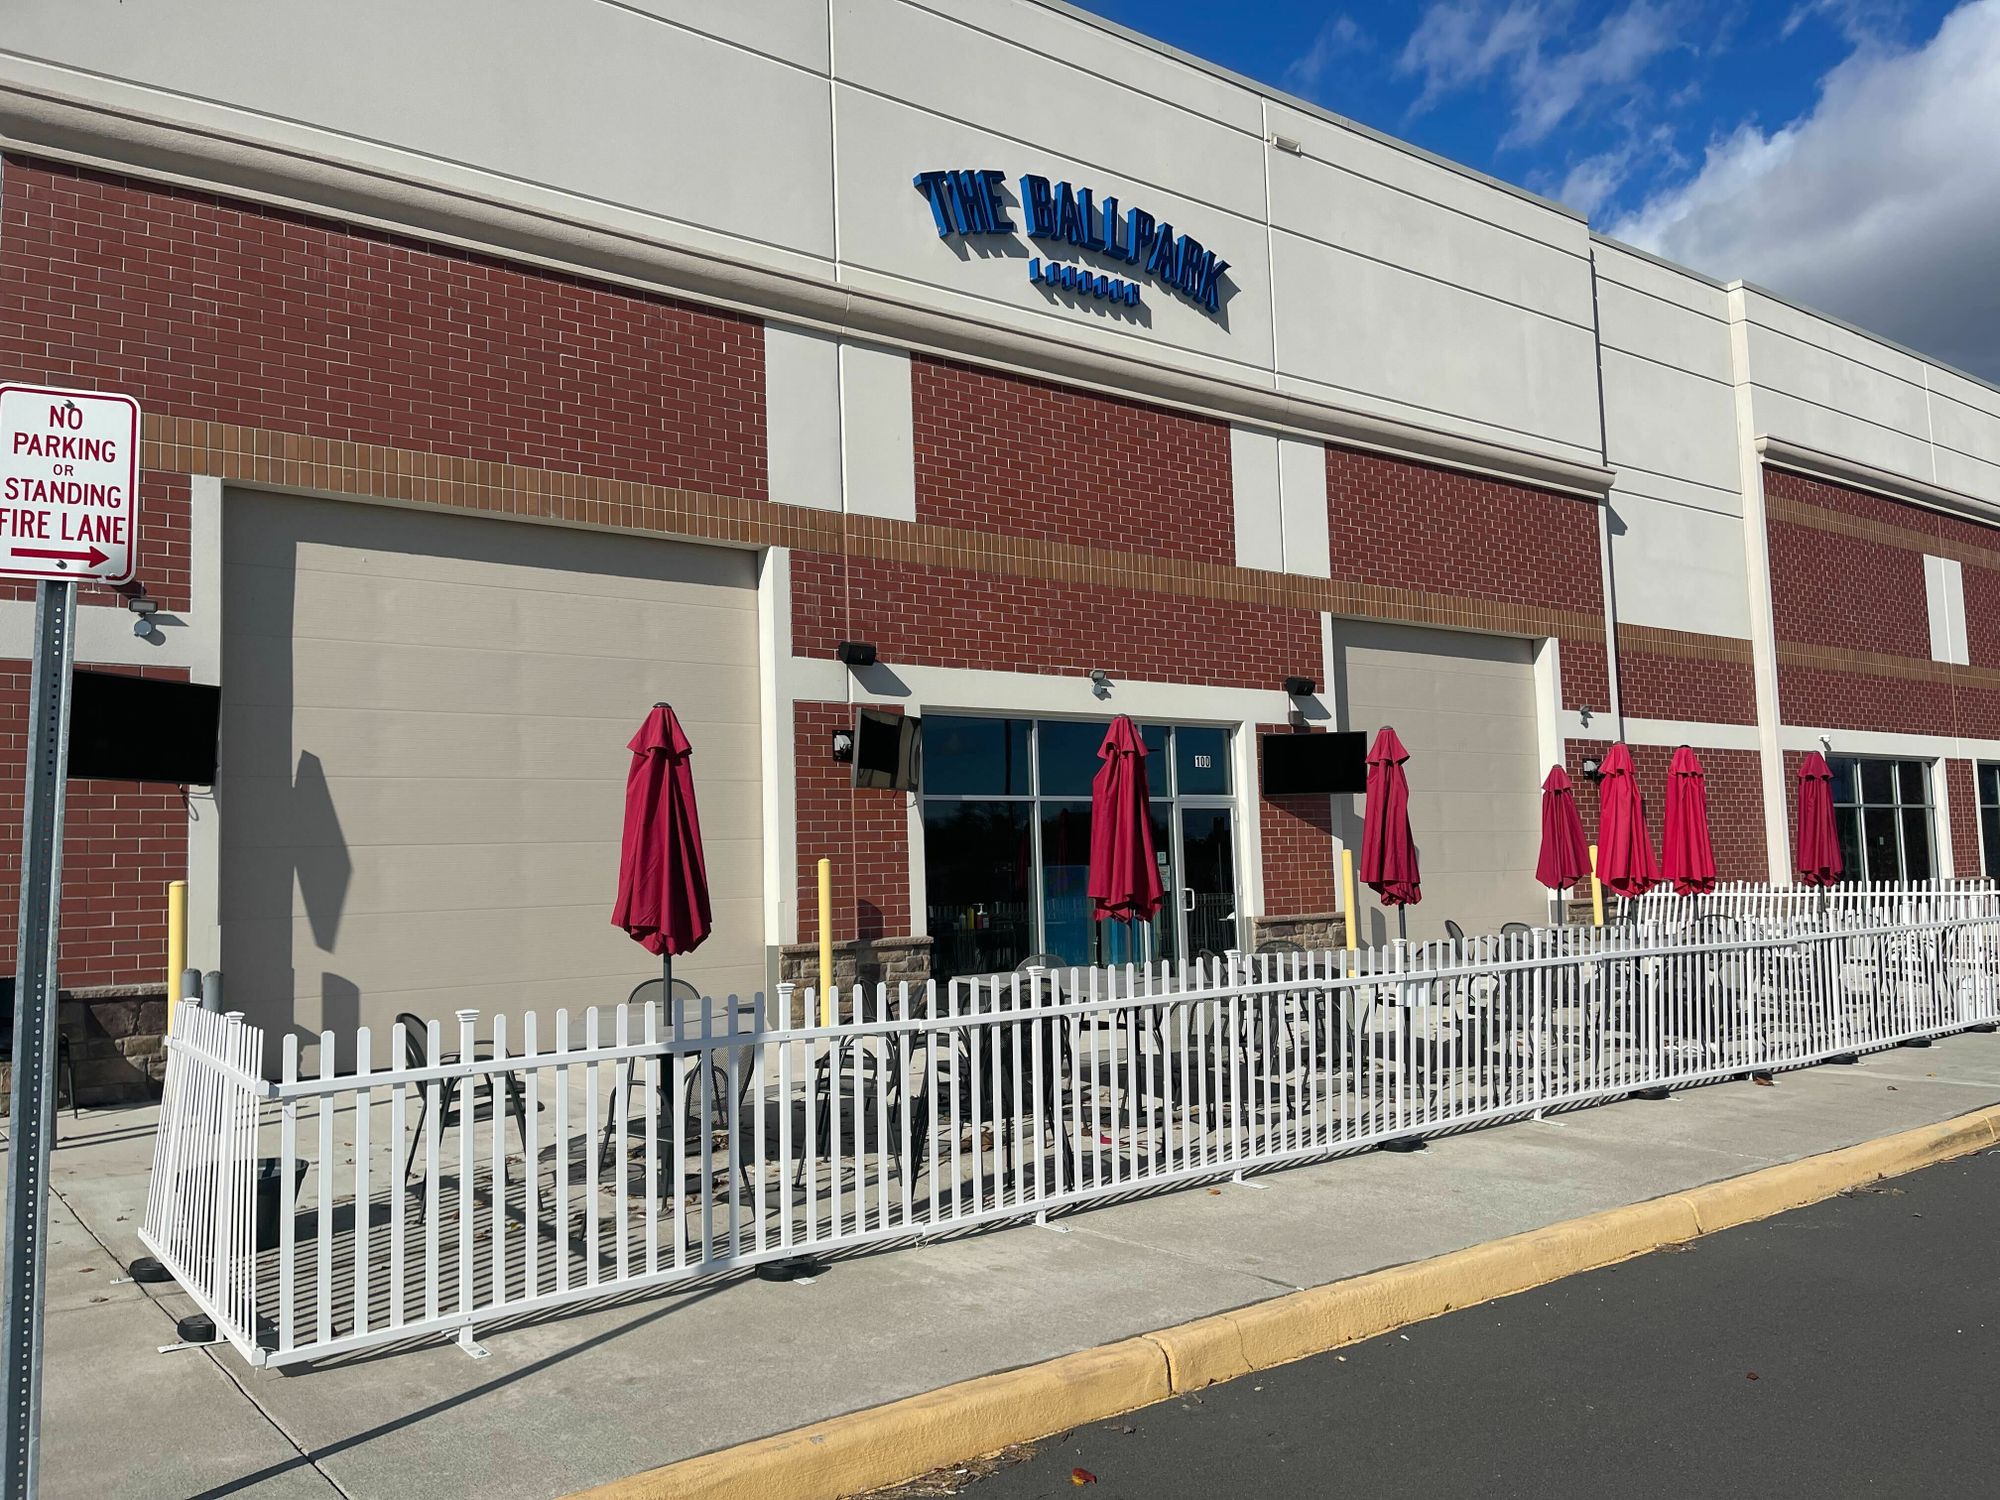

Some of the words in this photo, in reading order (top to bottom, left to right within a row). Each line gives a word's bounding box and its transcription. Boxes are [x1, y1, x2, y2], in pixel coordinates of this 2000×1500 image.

[913, 169, 1018, 238] THE
[1019, 173, 1232, 314] BALLPARK
[49, 405, 83, 430] NO
[13, 431, 116, 463] PARKING
[53, 463, 74, 477] OR
[4, 477, 121, 509] STANDING
[0, 507, 51, 539] FIRE
[61, 512, 126, 545] LANE
[1195, 756, 1210, 767] 100
